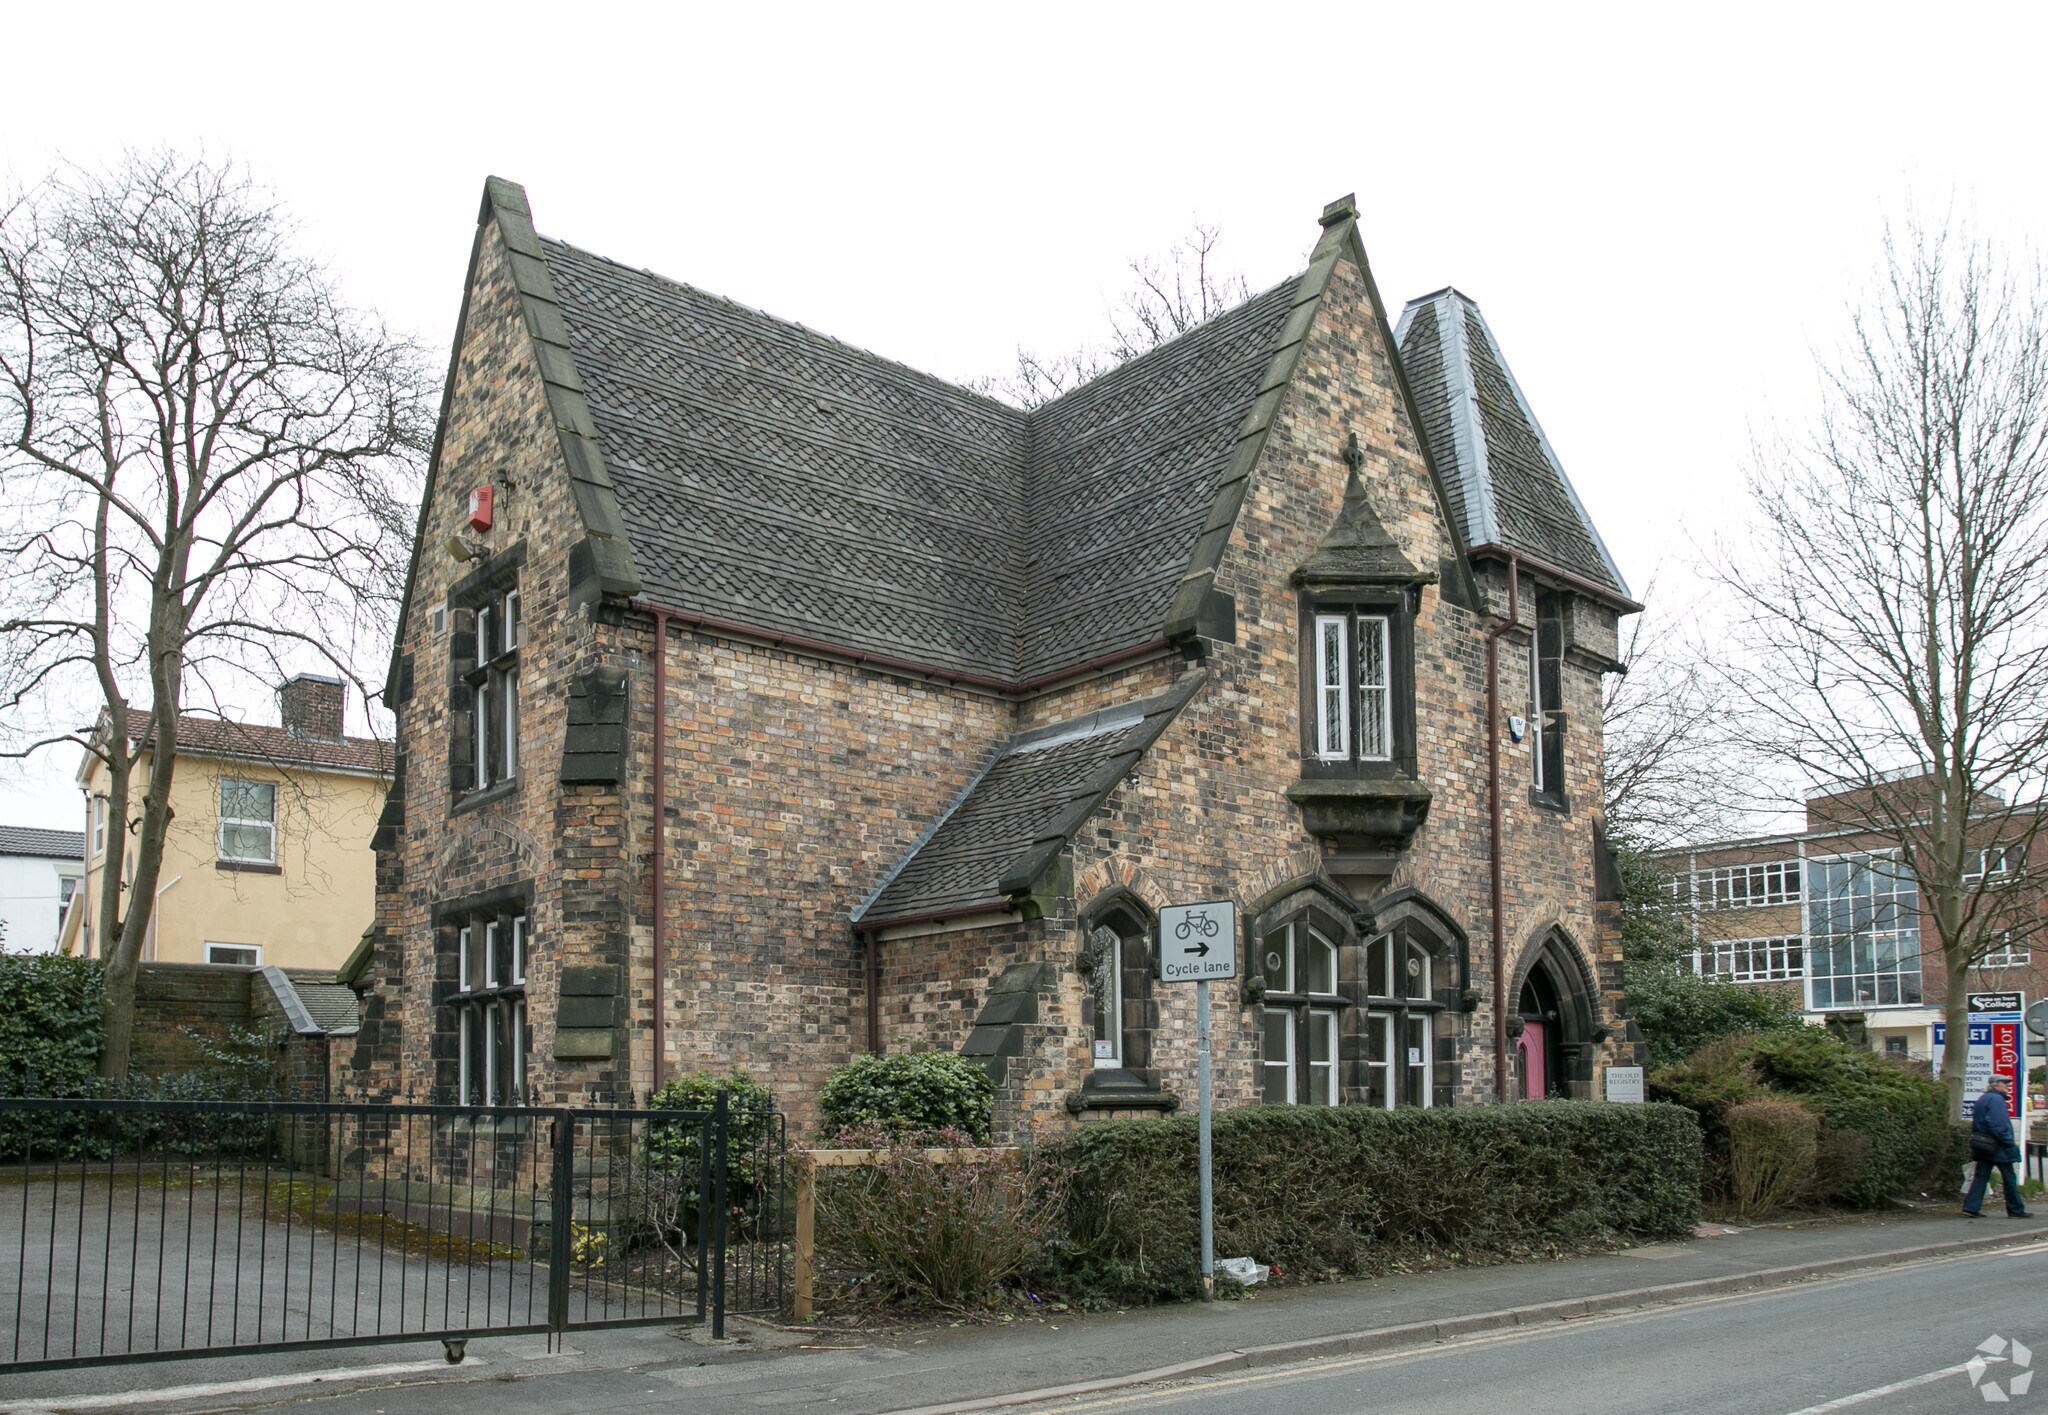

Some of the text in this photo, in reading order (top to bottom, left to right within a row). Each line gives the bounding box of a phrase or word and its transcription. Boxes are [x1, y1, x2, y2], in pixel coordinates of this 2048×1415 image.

[1166, 962, 1230, 976] Cycle lane
[1995, 1028, 2019, 1072] Taylor
